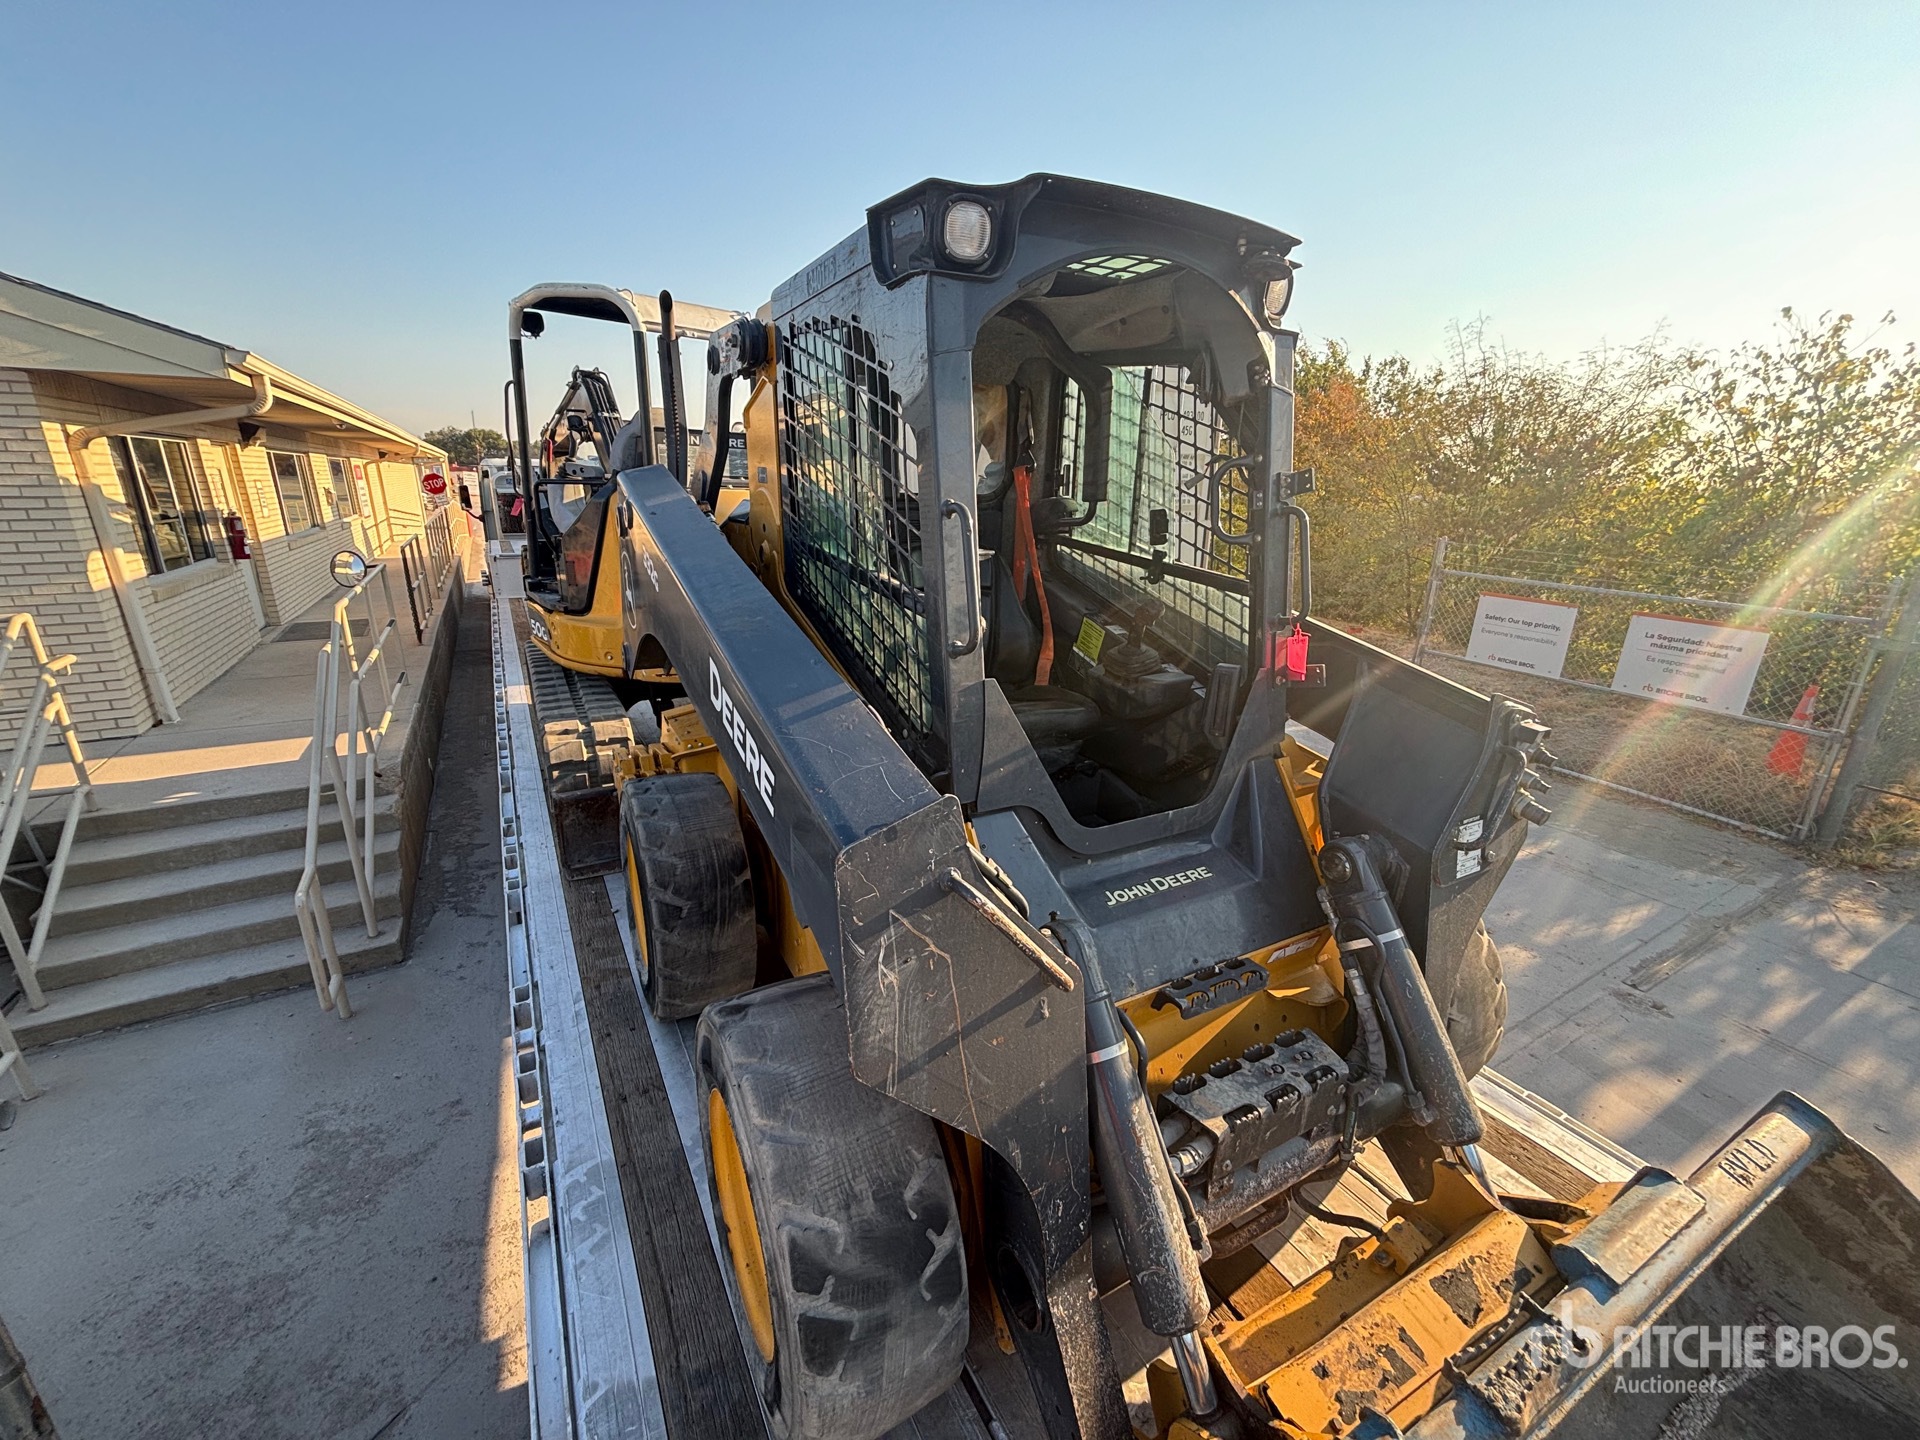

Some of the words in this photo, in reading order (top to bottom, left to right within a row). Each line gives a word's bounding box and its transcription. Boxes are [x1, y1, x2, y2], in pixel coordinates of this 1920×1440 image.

[423, 477, 444, 490] STOP
[1484, 613, 1507, 623] Safety:
[1507, 617, 1521, 625] Our
[1521, 619, 1534, 628] top
[1533, 622, 1561, 632] priority.
[1480, 627, 1514, 638] Everyone's
[1644, 631, 1655, 639] La
[1656, 633, 1705, 647] Seguridad:
[1705, 640, 1743, 652] Nuestra
[1649, 641, 1685, 653] máxima
[1685, 647, 1730, 660] prioridad.
[1497, 656, 1518, 666] RITCHIE
[1662, 666, 1674, 674] de
[1655, 687, 1685, 699] RITCHIE
[709, 656, 775, 818] DEERE
[1105, 882, 1155, 906] JOHN
[1150, 866, 1213, 891] DEERE
